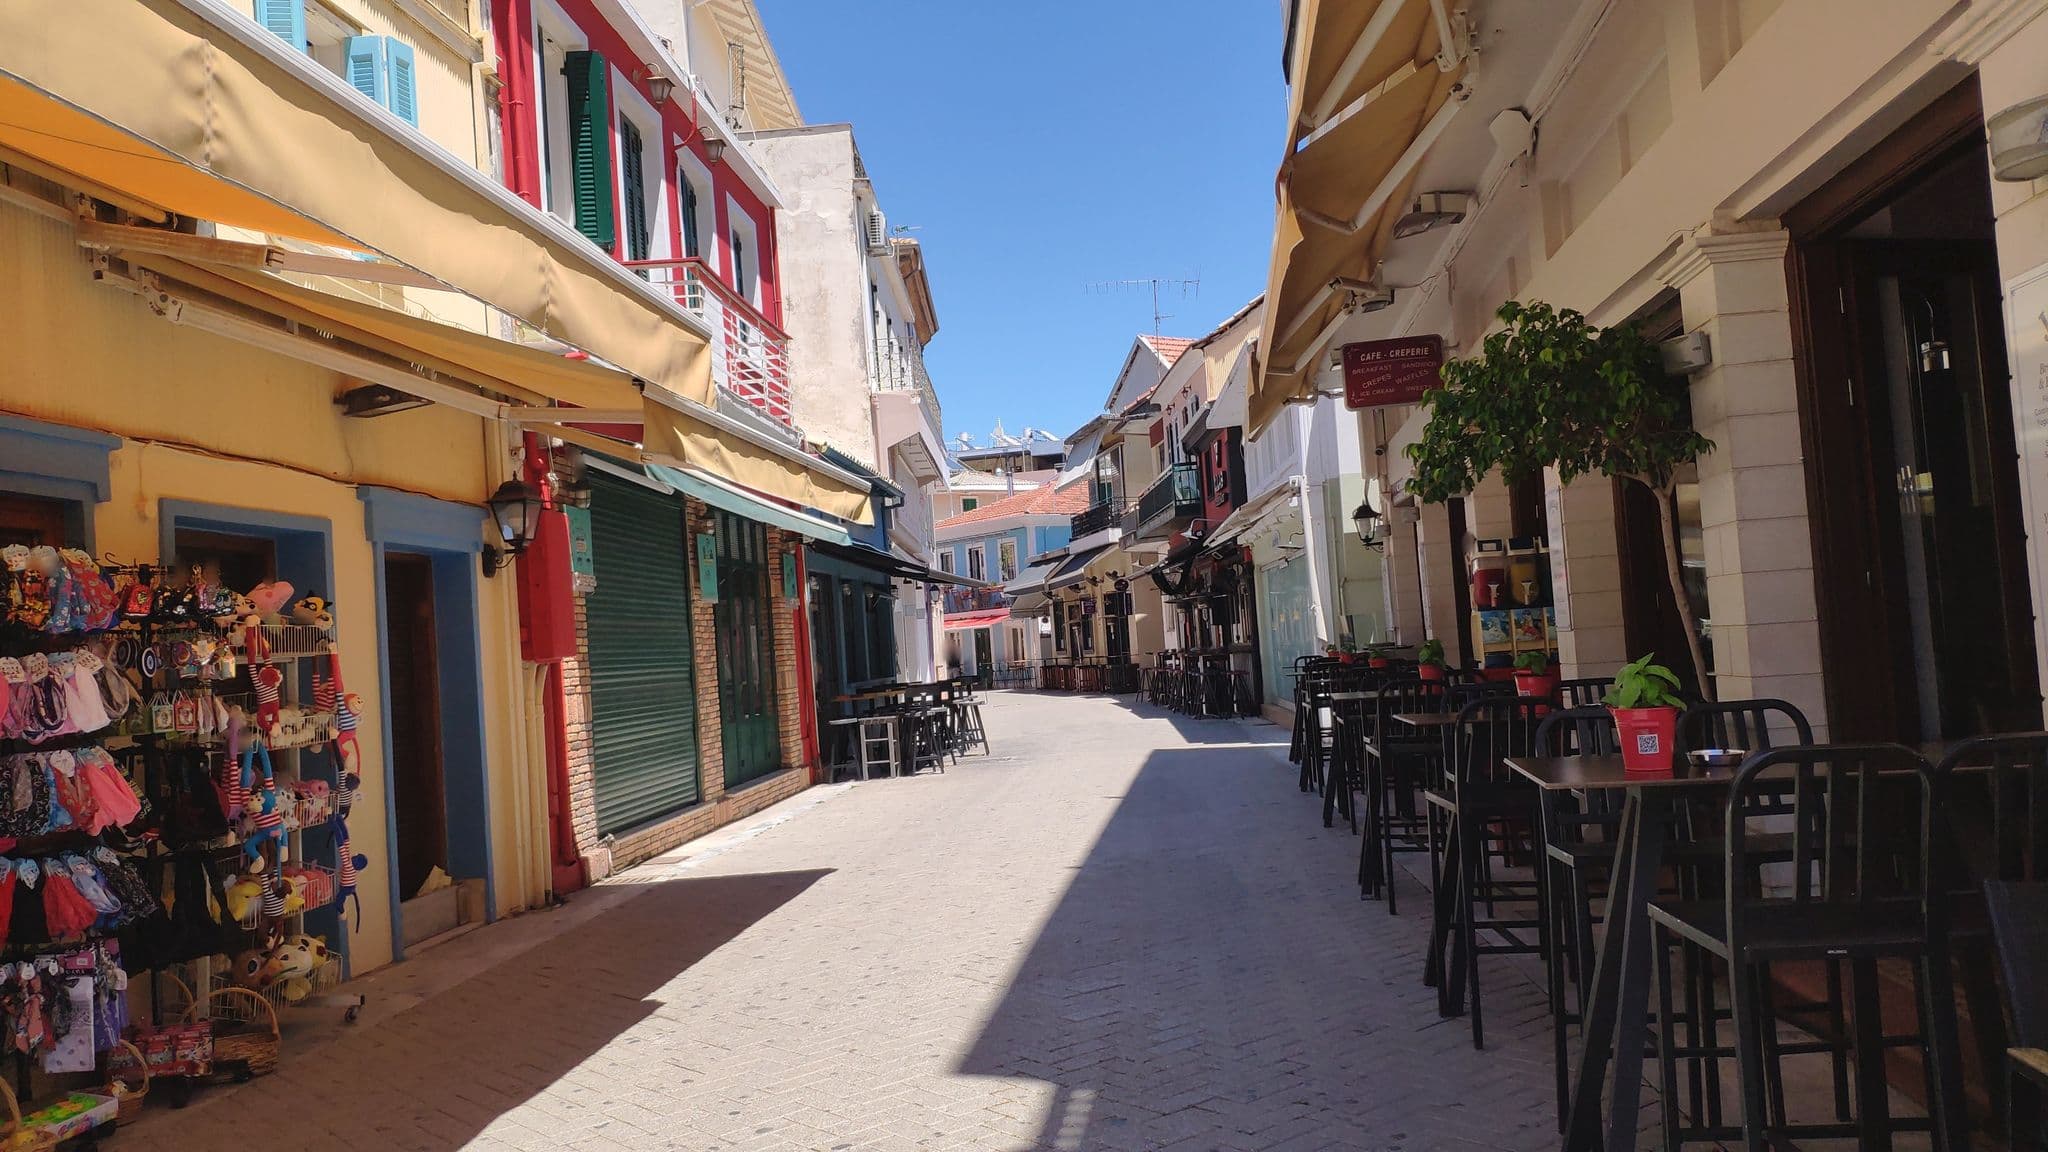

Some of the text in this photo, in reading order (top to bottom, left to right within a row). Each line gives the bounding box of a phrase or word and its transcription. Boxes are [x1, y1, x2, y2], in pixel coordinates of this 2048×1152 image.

[1360, 352, 1382, 362] CAFE
[1389, 347, 1430, 358] CREPERIE
[1351, 364, 1393, 375] BREAKFAST
[1362, 369, 1429, 389] CREPES WAFFLES
[1372, 387, 1395, 397] CREAM
